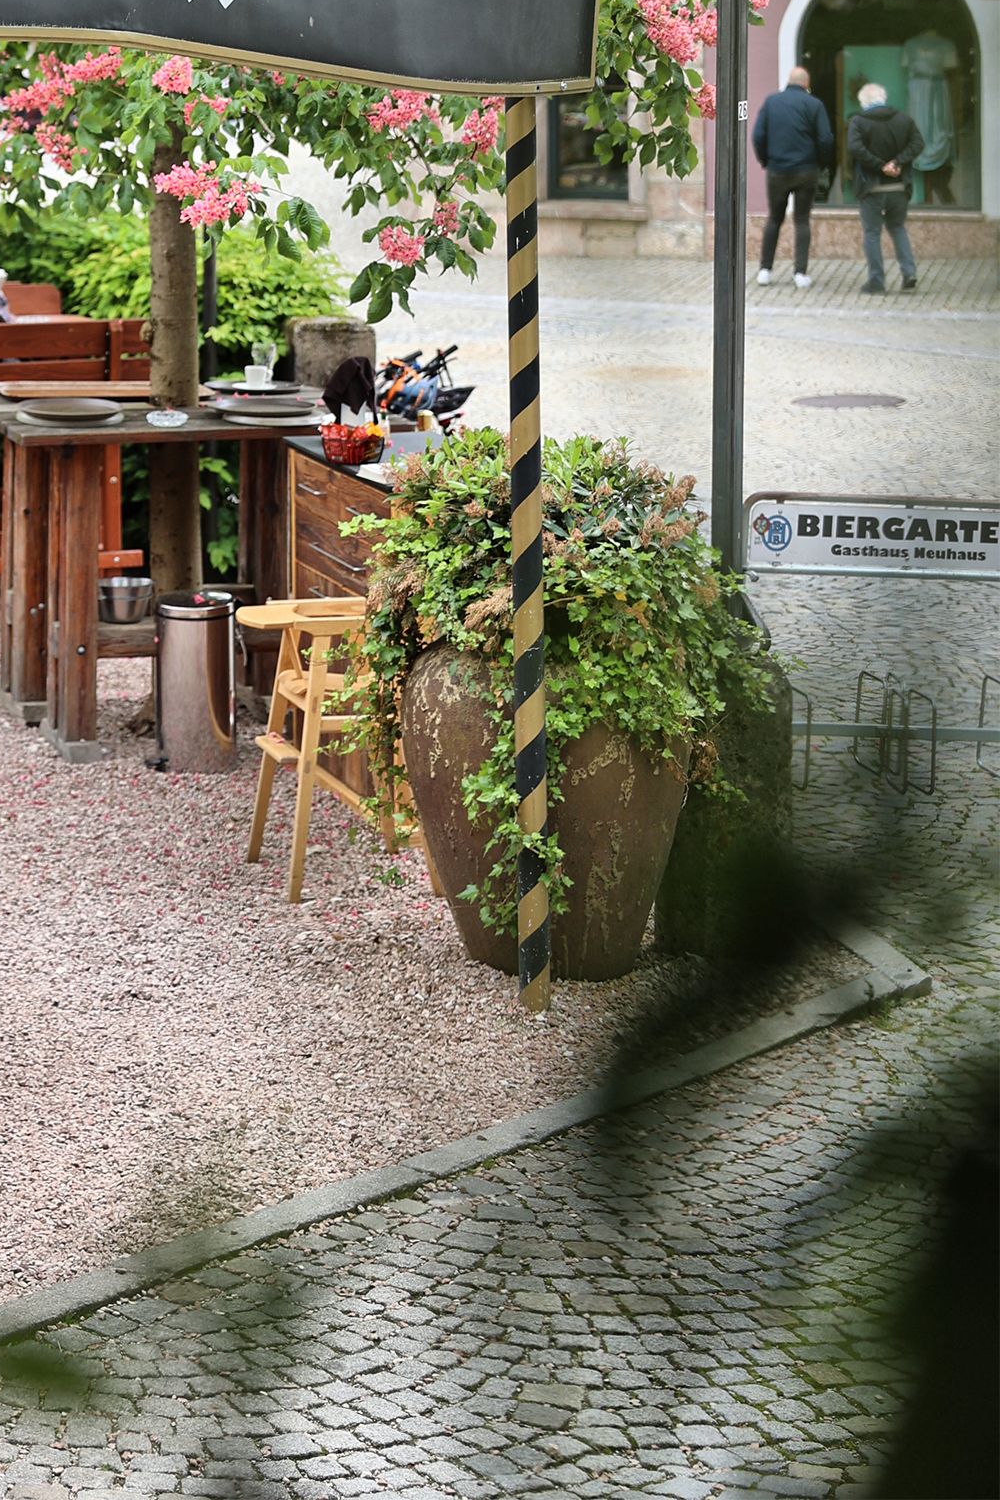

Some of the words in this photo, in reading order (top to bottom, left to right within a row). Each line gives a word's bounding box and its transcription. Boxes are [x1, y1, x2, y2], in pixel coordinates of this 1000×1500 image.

[797, 514, 999, 544] BIERGARTE
[831, 544, 909, 559] Gasthaus
[914, 547, 986, 562] Neuhaus
